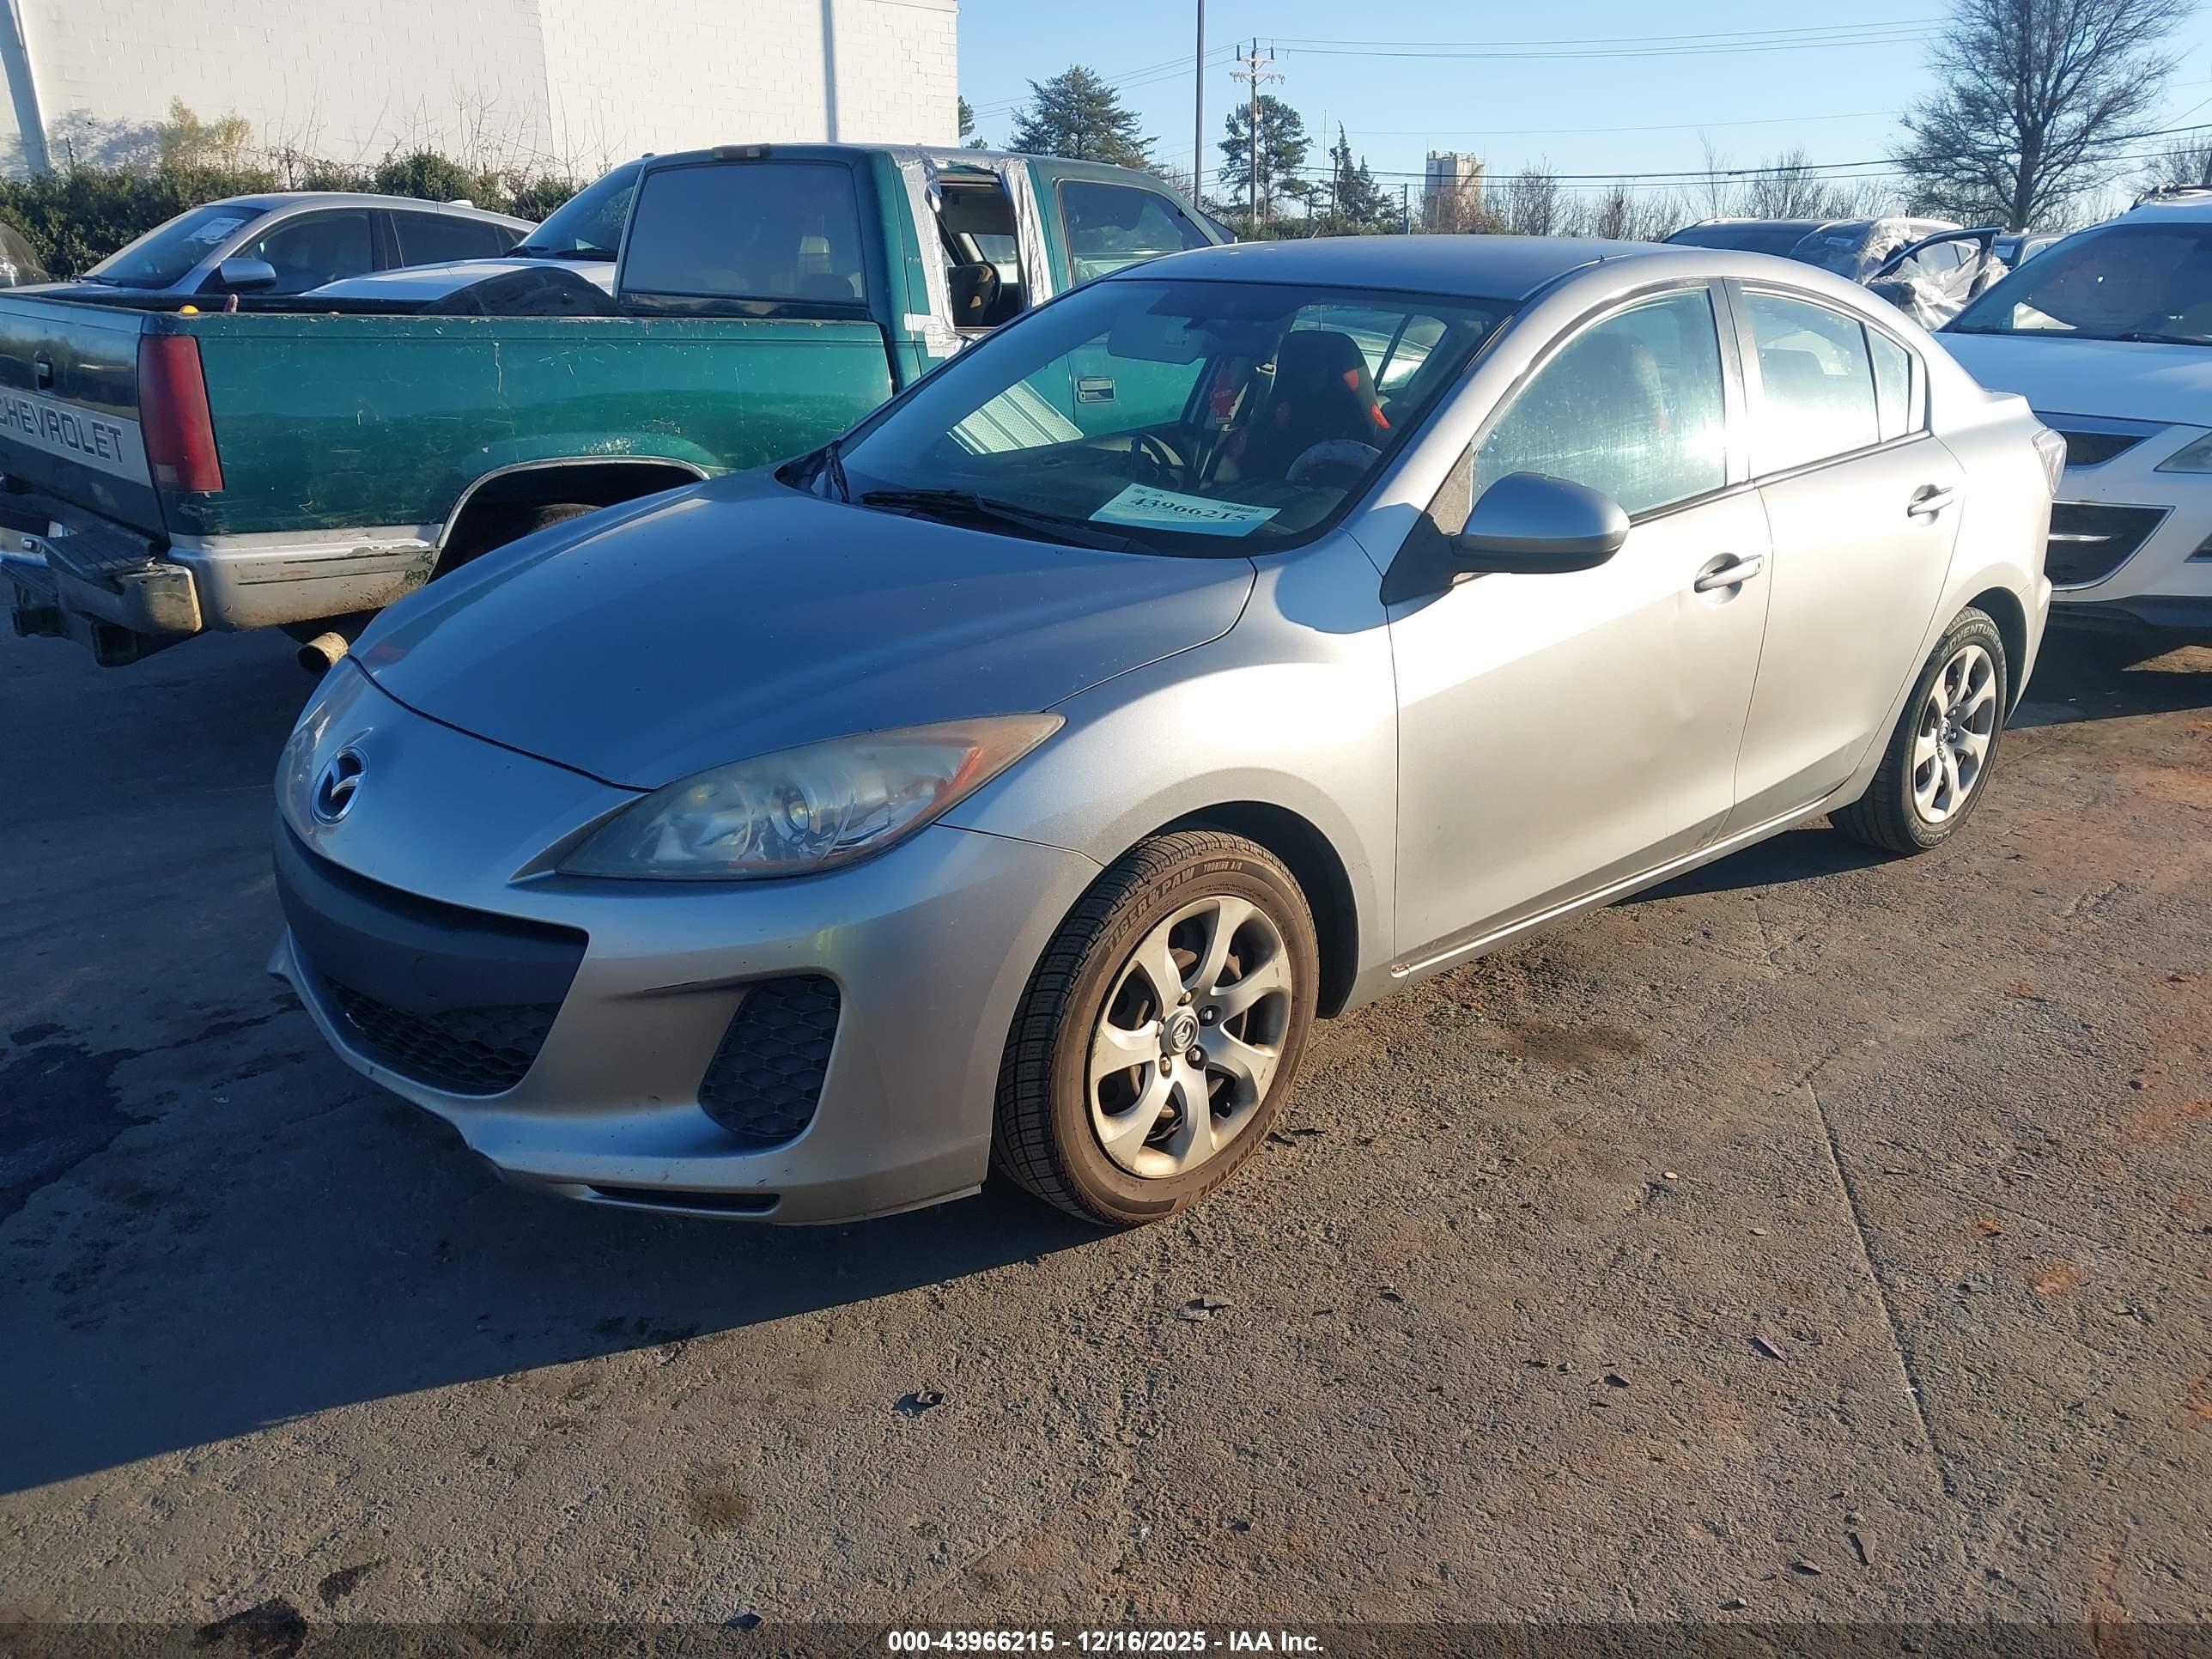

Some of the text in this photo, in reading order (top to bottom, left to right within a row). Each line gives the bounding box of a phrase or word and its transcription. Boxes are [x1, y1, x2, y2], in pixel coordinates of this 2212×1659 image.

[1130, 497, 1250, 521] 43966215
[1941, 623, 2003, 662] ADVENTURER
[1908, 816, 1951, 844] COOPER
[1203, 860, 1230, 873] TOURING
[1104, 901, 1149, 953] TIGER
[1161, 866, 1196, 895] PAW
